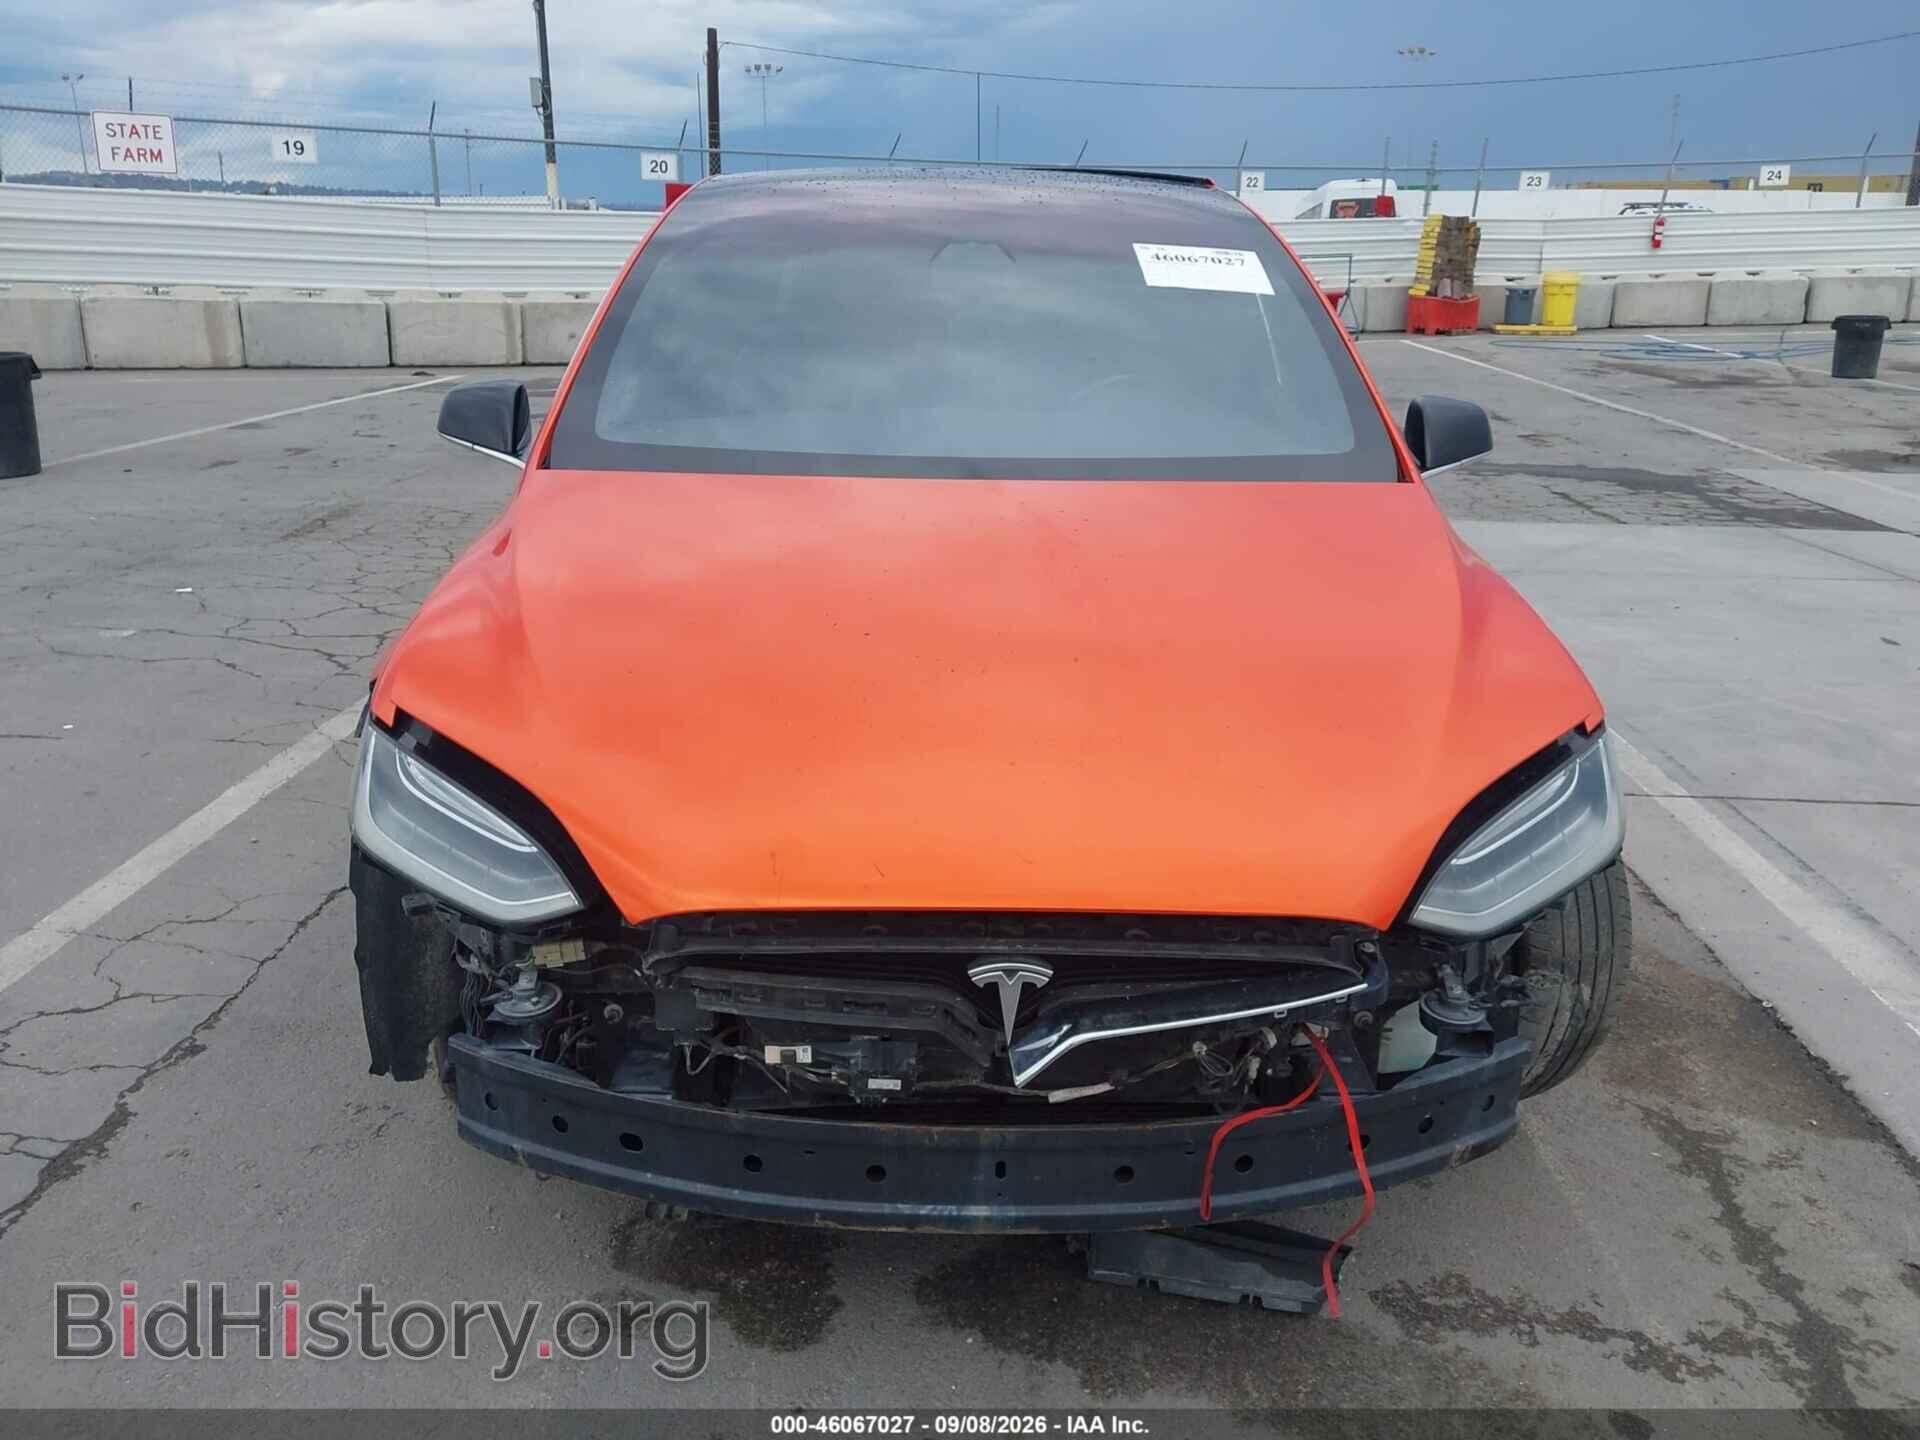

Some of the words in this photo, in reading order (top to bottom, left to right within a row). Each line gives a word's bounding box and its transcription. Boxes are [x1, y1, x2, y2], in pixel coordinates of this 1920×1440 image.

[105, 122, 164, 140] STATE
[111, 146, 164, 163] FARM
[282, 140, 305, 156] 19
[650, 159, 669, 173] 20
[1246, 176, 1259, 188] 22
[1526, 176, 1542, 187] 23
[1766, 169, 1783, 181] 24
